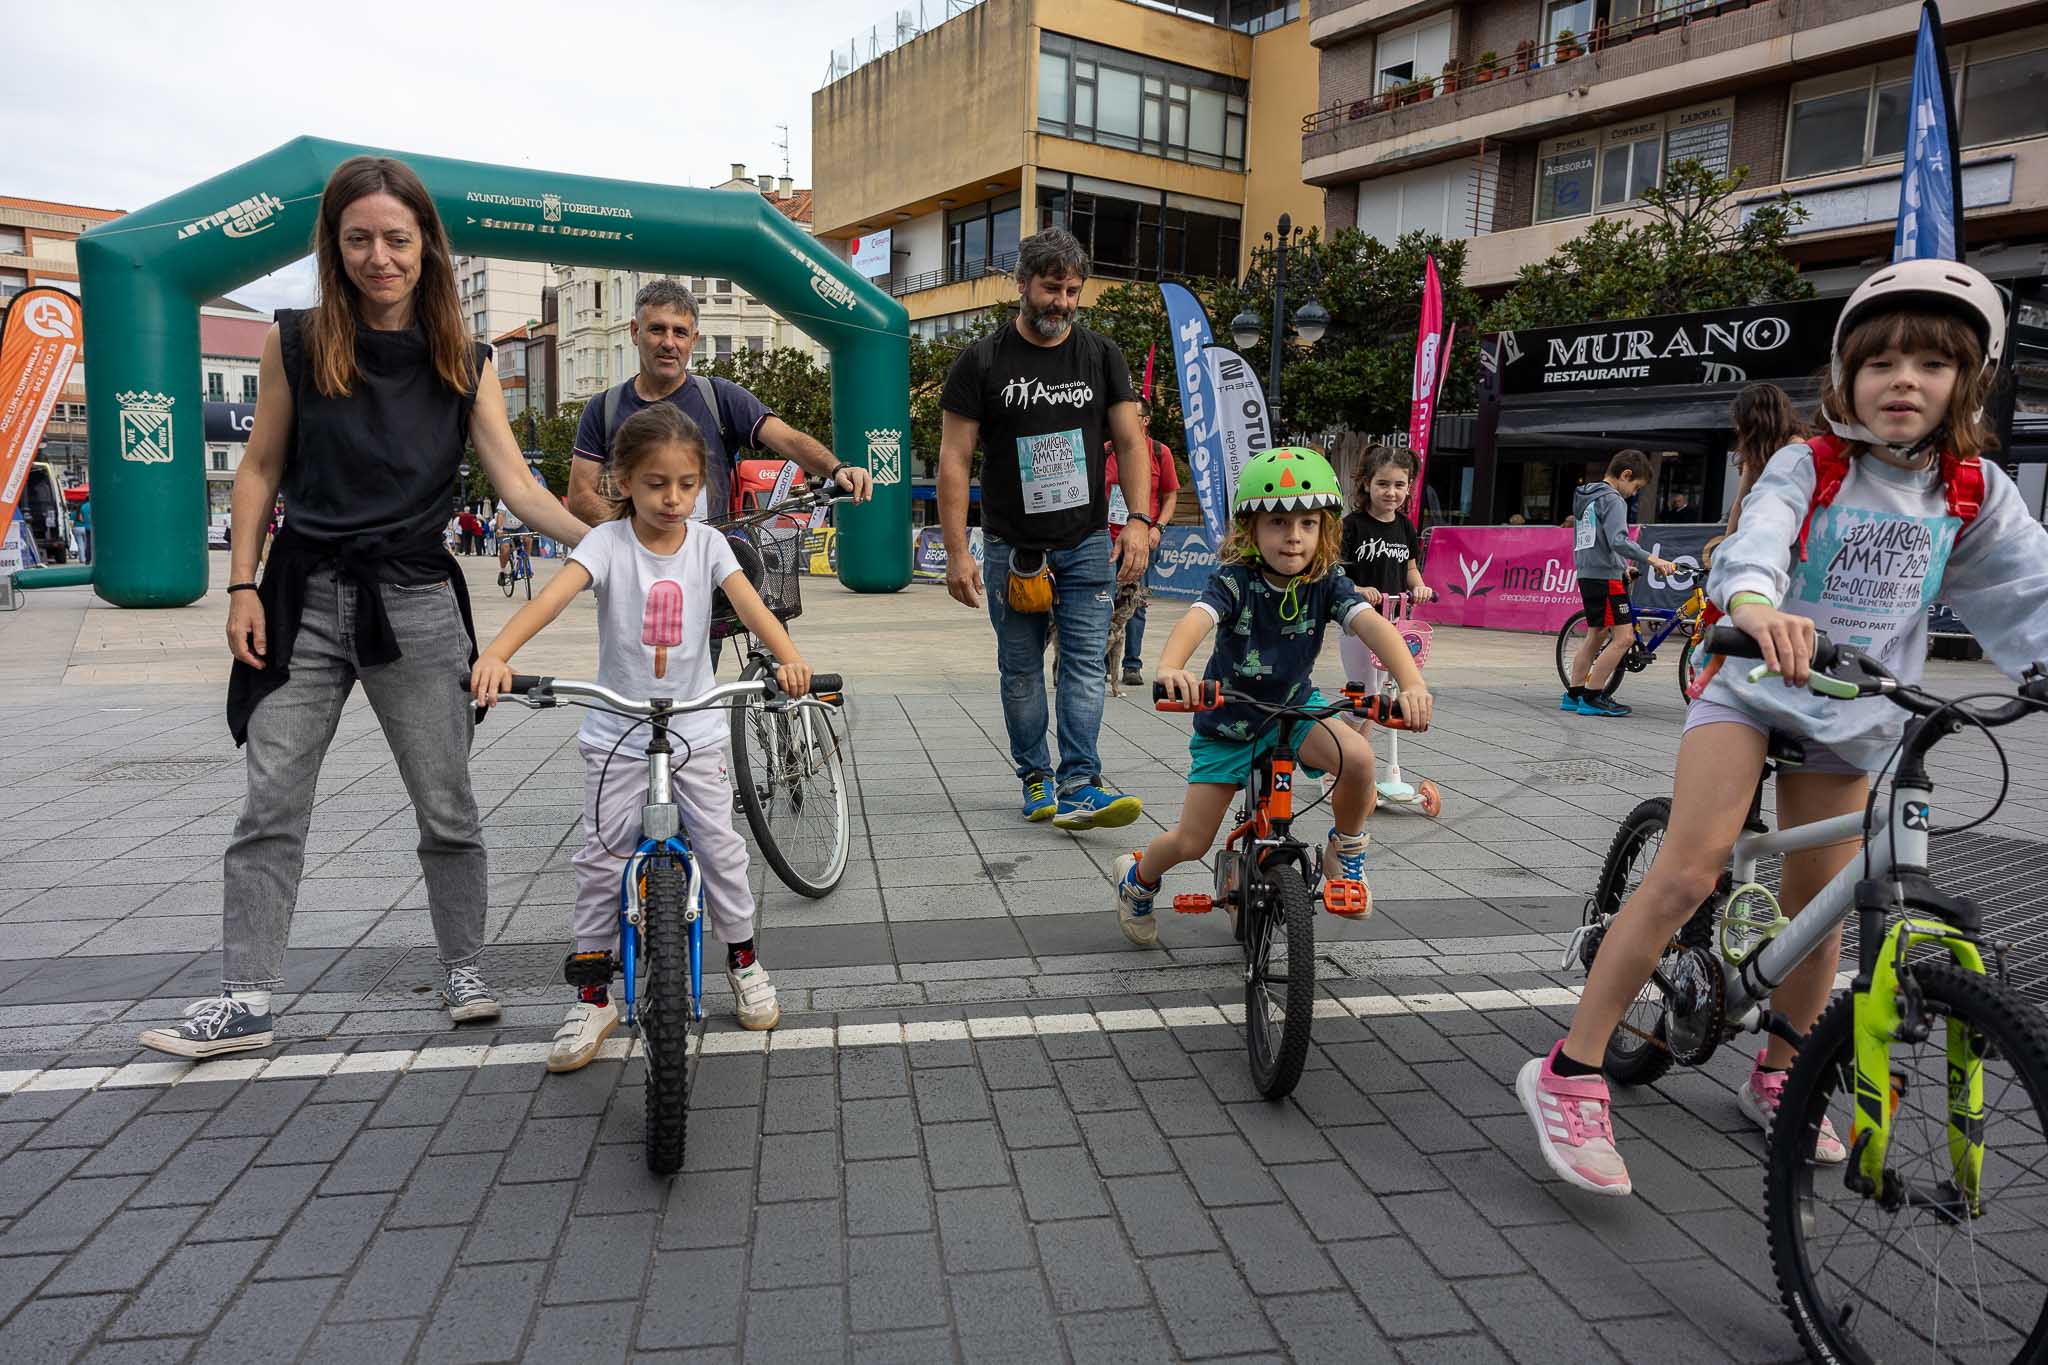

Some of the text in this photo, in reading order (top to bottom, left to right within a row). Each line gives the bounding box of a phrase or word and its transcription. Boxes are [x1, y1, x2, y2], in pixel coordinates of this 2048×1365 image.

[466, 192, 633, 219] AYUNTAMIENTO TORRELAVEGA
[560, 225, 622, 241] DEPORTE
[1545, 317, 1791, 367] MURANO
[1046, 380, 1086, 391] fundación
[1543, 366, 1650, 384] RESTAURANTE
[127, 428, 136, 444] AVE
[1860, 520, 1932, 552] MARCHA
[1828, 544, 1929, 579] AMAT 2024
[1824, 575, 1841, 592] 12
[1849, 578, 1900, 600] OCTUBRE
[1830, 616, 1897, 631] GRUPO PARTE
